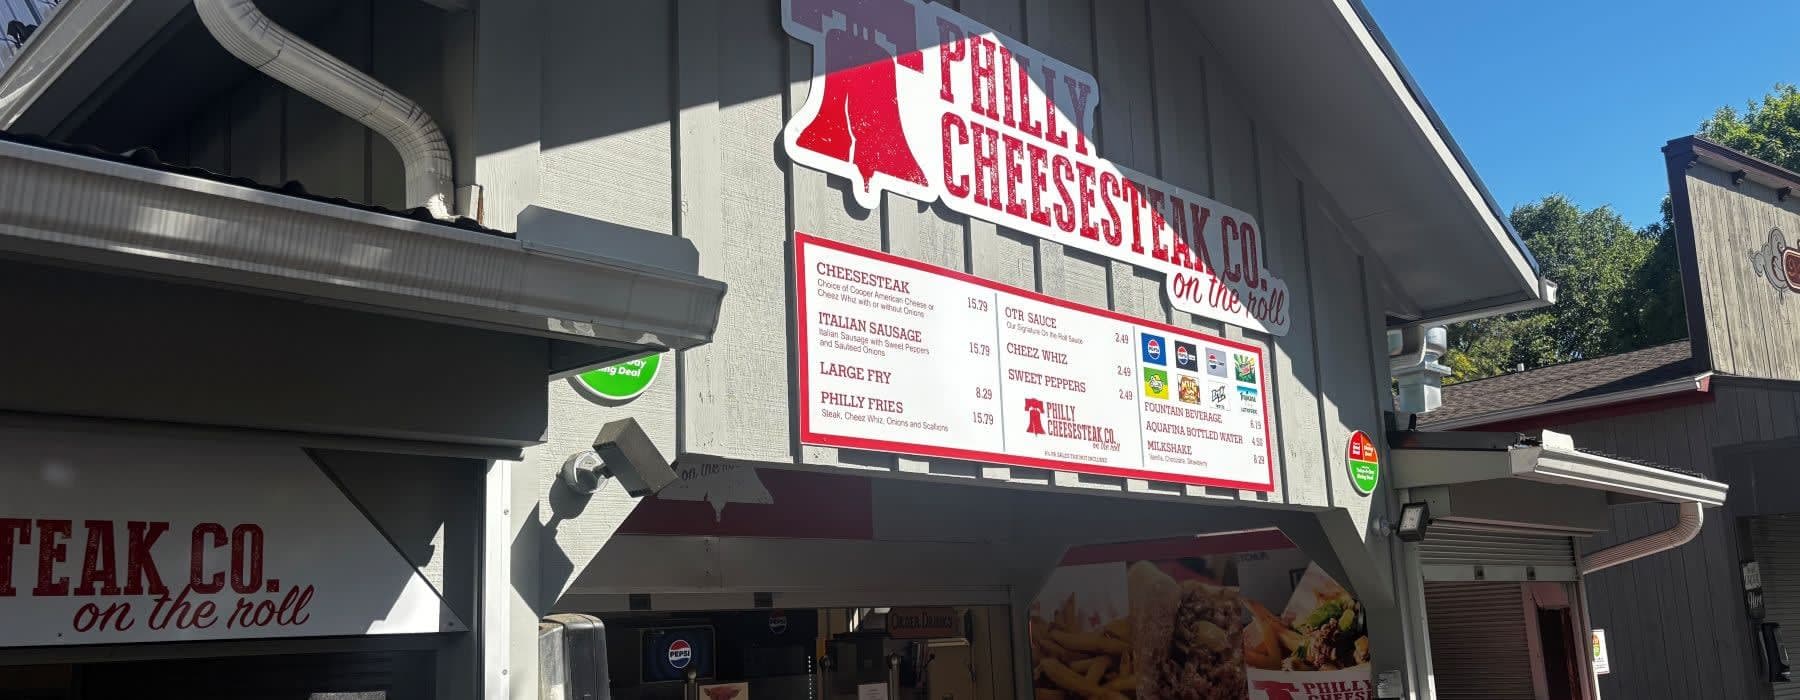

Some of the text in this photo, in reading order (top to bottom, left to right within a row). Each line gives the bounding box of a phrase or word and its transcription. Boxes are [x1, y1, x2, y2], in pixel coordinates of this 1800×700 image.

[936, 16, 1090, 156] PHILLY
[941, 111, 1267, 291] CHEESESTEAK CO.
[816, 261, 989, 313] CHEESESTEAK 15.79
[817, 278, 841, 291] Choice
[841, 284, 849, 292] of
[849, 286, 873, 298] Cooper
[874, 290, 904, 303] American
[904, 297, 928, 308] Cheese
[817, 288, 839, 300] Cheez
[840, 294, 857, 304] Whiz
[858, 298, 872, 307] with
[880, 303, 902, 313] without
[903, 307, 925, 318] Onions
[1173, 268, 1286, 326] on the roll
[818, 311, 991, 357] ITALIAN SAUSAGE 15.79
[818, 327, 930, 355] Italian Sausage with Sweet Peppers
[1005, 306, 1129, 344] OTR SAUCE 2.49
[819, 339, 833, 348] and
[862, 345, 886, 356] Onions
[1006, 342, 1131, 377] CHEEZ WHIZ 2.49
[618, 366, 641, 377] Deal
[819, 361, 992, 400] LARGE FRY 8.29
[1008, 368, 1133, 401] SWEET PEPPERS 2.49
[820, 391, 994, 425] PHILLY FRIES 15.79
[821, 409, 843, 420] Steak,
[844, 412, 865, 422] Cheez
[886, 416, 909, 427] Onions
[909, 420, 922, 429] and
[922, 421, 949, 432] Scallions
[1046, 401, 1075, 421] PHILLY
[1144, 401, 1184, 417] FOUNTAIN
[1185, 408, 1223, 424] BEVERAGE
[1047, 419, 1116, 444] CHEESESTEAK CO.
[1146, 420, 1186, 436] AQUAFINA
[1186, 427, 1219, 441] BOTTLED
[1219, 431, 1243, 444] WATER
[1147, 440, 1192, 455] MILKSHAKE
[190, 522, 280, 595] CO.
[73, 585, 315, 633] on the roll
